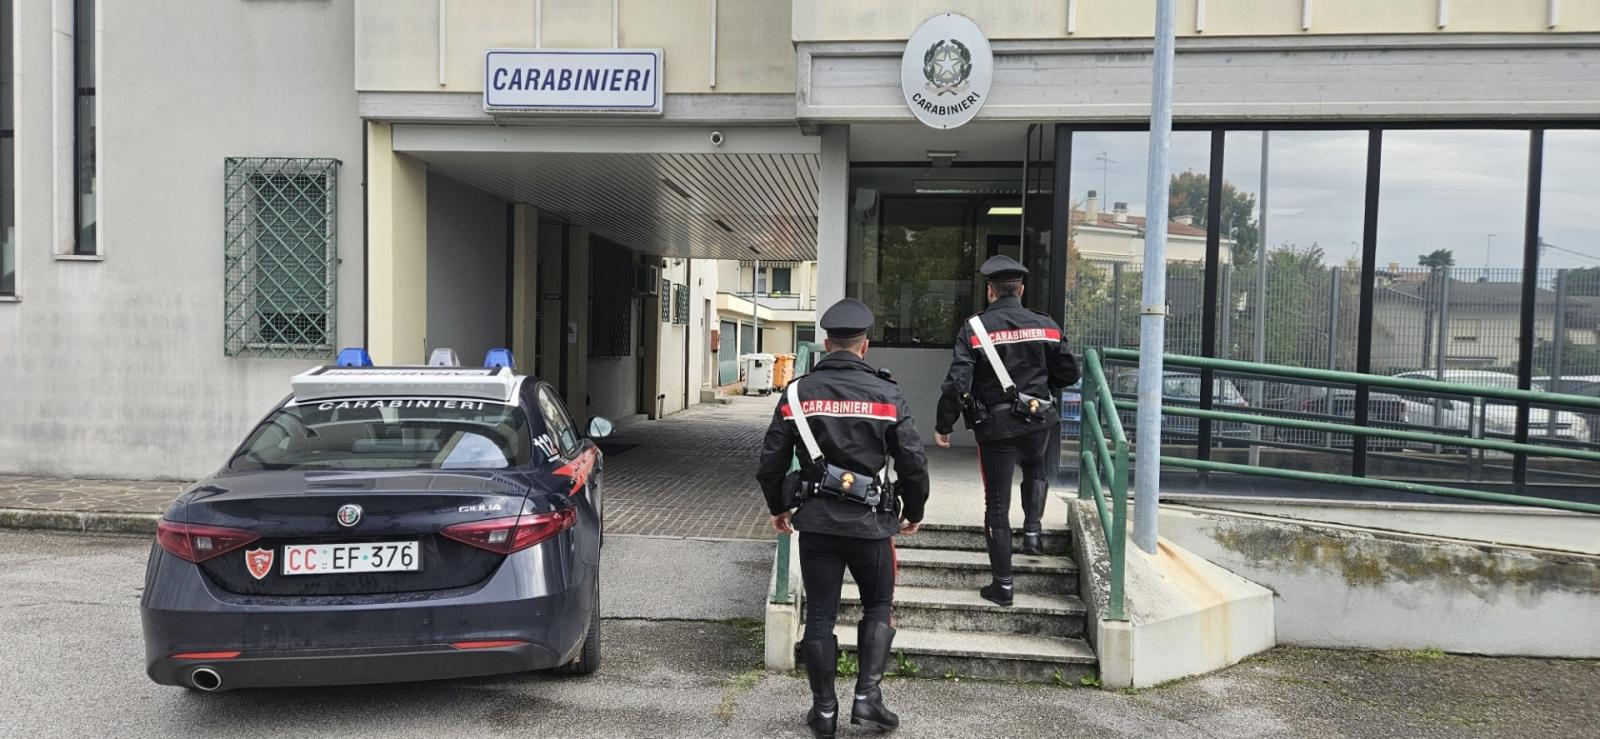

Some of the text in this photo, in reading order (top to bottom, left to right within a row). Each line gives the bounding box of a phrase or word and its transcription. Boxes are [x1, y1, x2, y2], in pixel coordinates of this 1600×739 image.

[493, 67, 650, 91] CARABINIERI
[911, 91, 981, 116] CARABINIERI
[989, 328, 1046, 343] CARABINIERI
[318, 399, 484, 411] CARABINIERI
[802, 401, 873, 415] CARABINIERI
[533, 433, 559, 459] 112
[458, 503, 502, 513] GIULIA
[288, 545, 413, 571] CC EF 376
